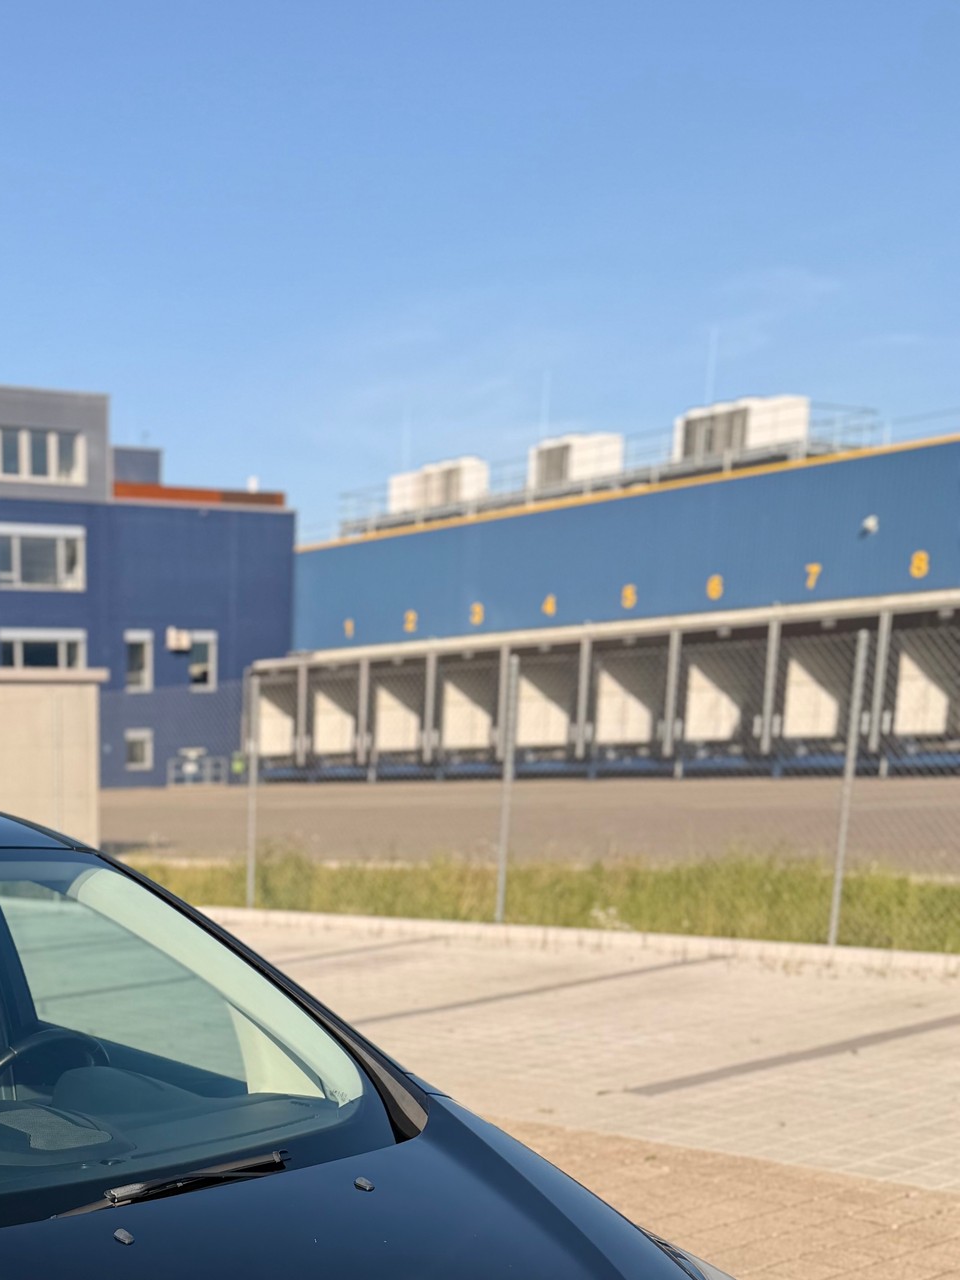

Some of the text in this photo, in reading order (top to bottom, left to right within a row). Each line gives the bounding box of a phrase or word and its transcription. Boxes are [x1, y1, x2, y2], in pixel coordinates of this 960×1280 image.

[806, 562, 822, 589] 7
[909, 550, 930, 579] 8
[621, 584, 637, 609] 5
[706, 574, 724, 601] 6
[470, 603, 484, 626] 3
[541, 594, 557, 616] 4
[404, 610, 417, 633] 2
